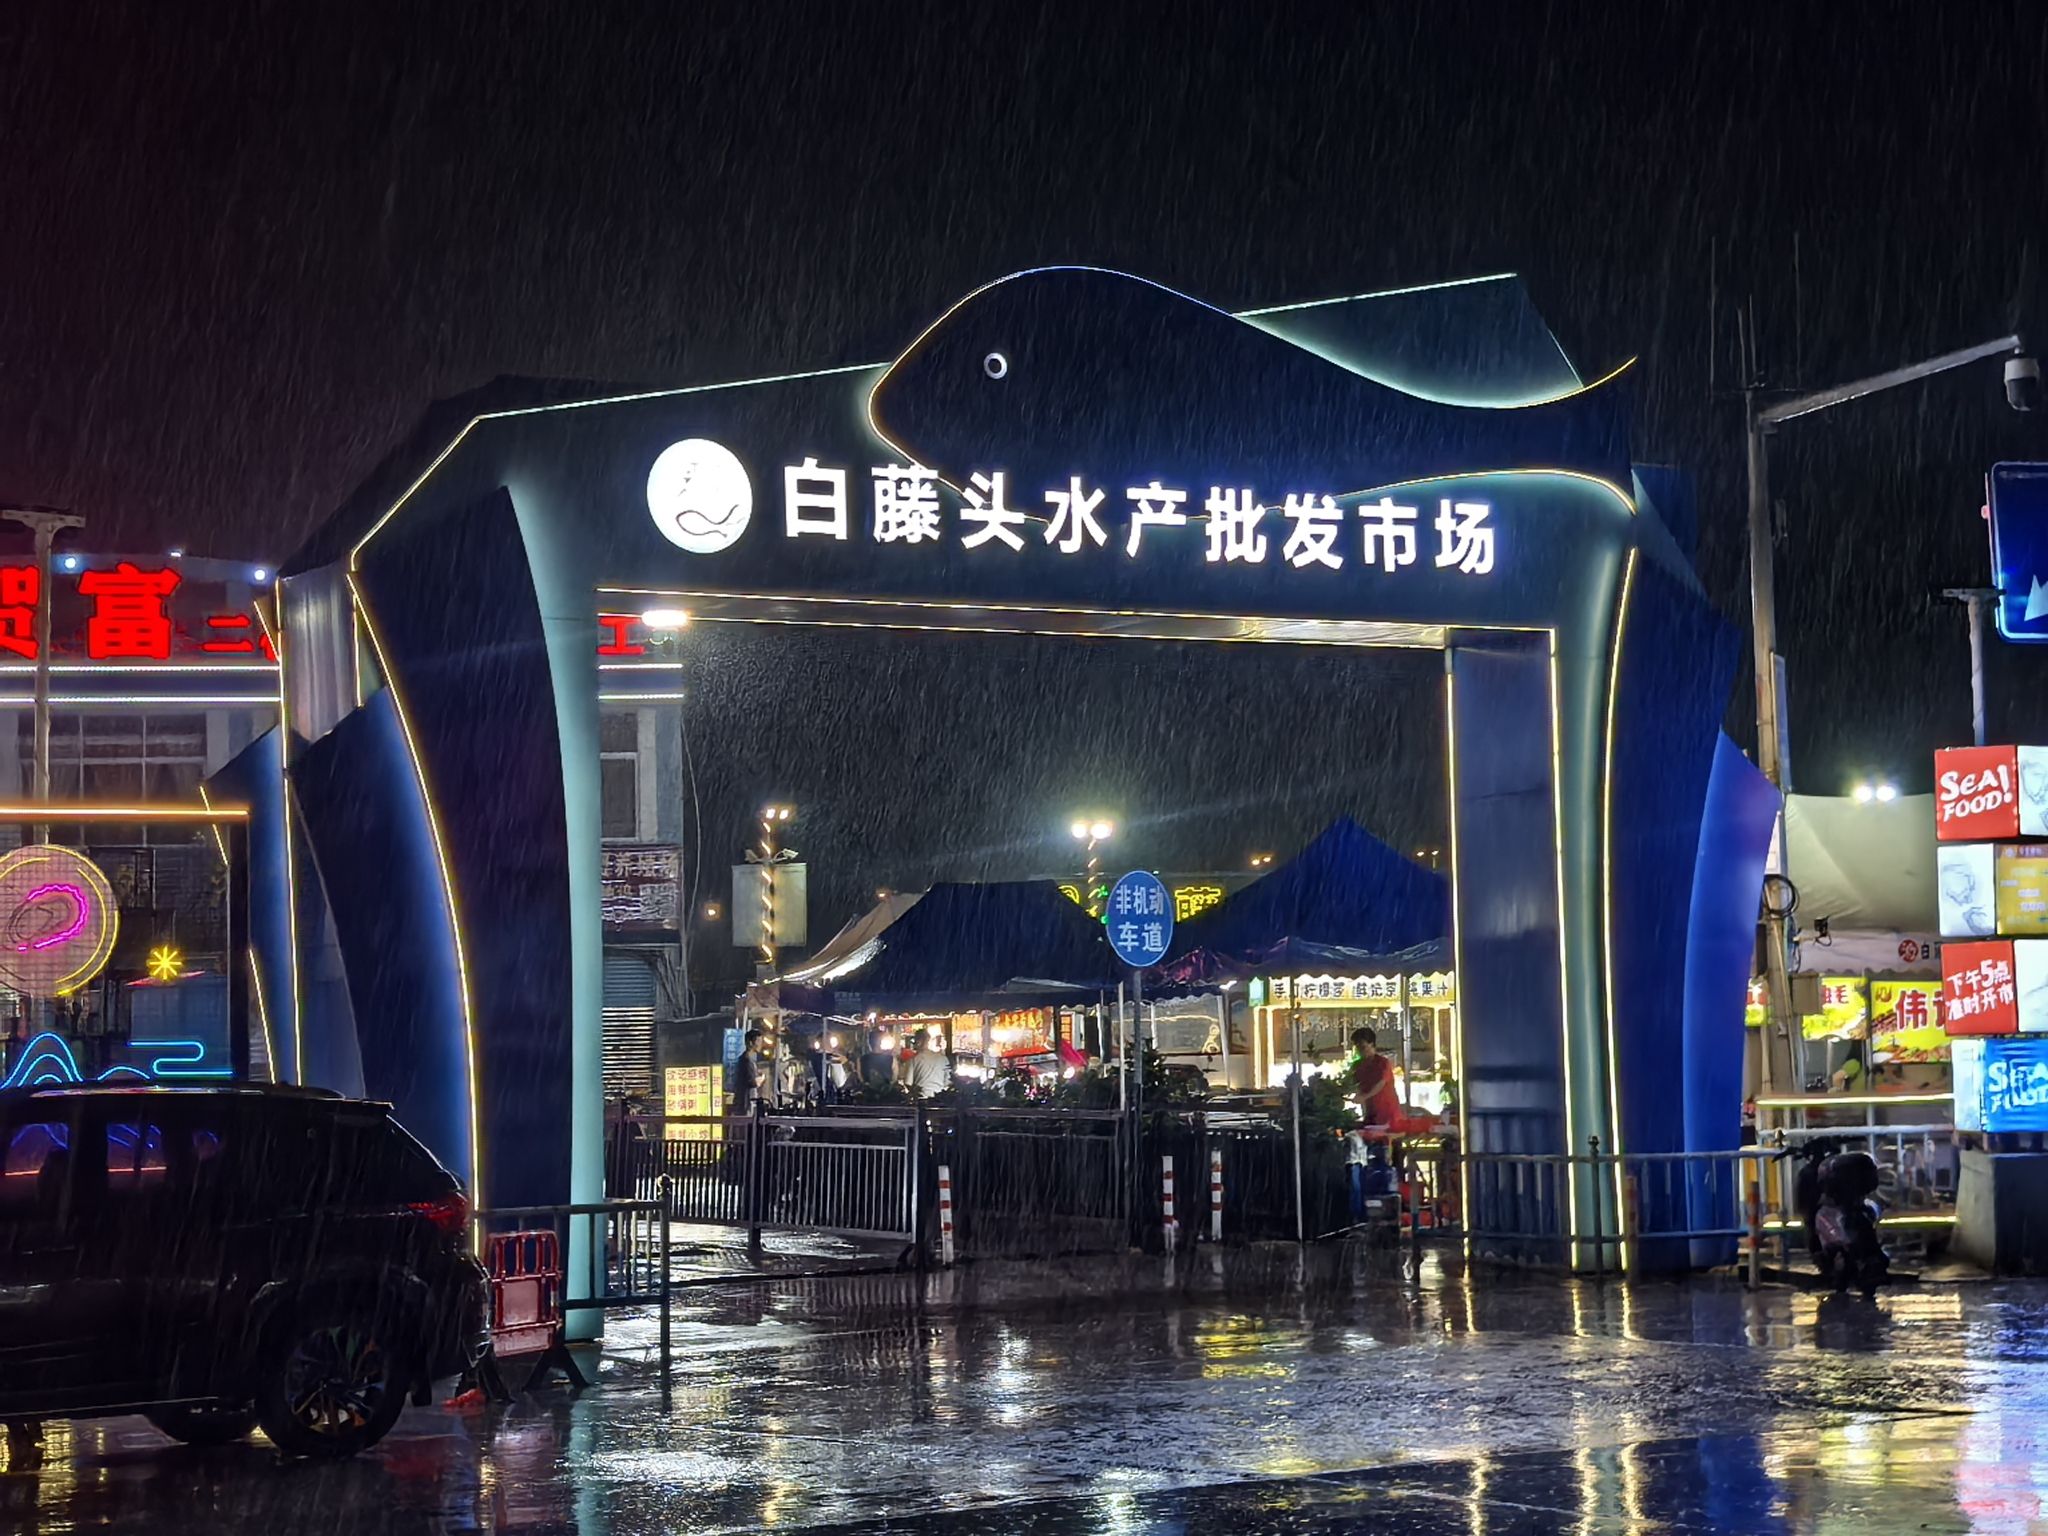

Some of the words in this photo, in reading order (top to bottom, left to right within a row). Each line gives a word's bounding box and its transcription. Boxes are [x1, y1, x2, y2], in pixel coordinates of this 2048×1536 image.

[782, 455, 1496, 575] 白藤头水产批发市场
[1943, 790, 2002, 823] FOOD
[1115, 885, 1164, 915] 非机动
[1117, 922, 1164, 952] 车道
[1947, 959, 2012, 996] 下午5点
[1946, 983, 2014, 1020] 准时开市
